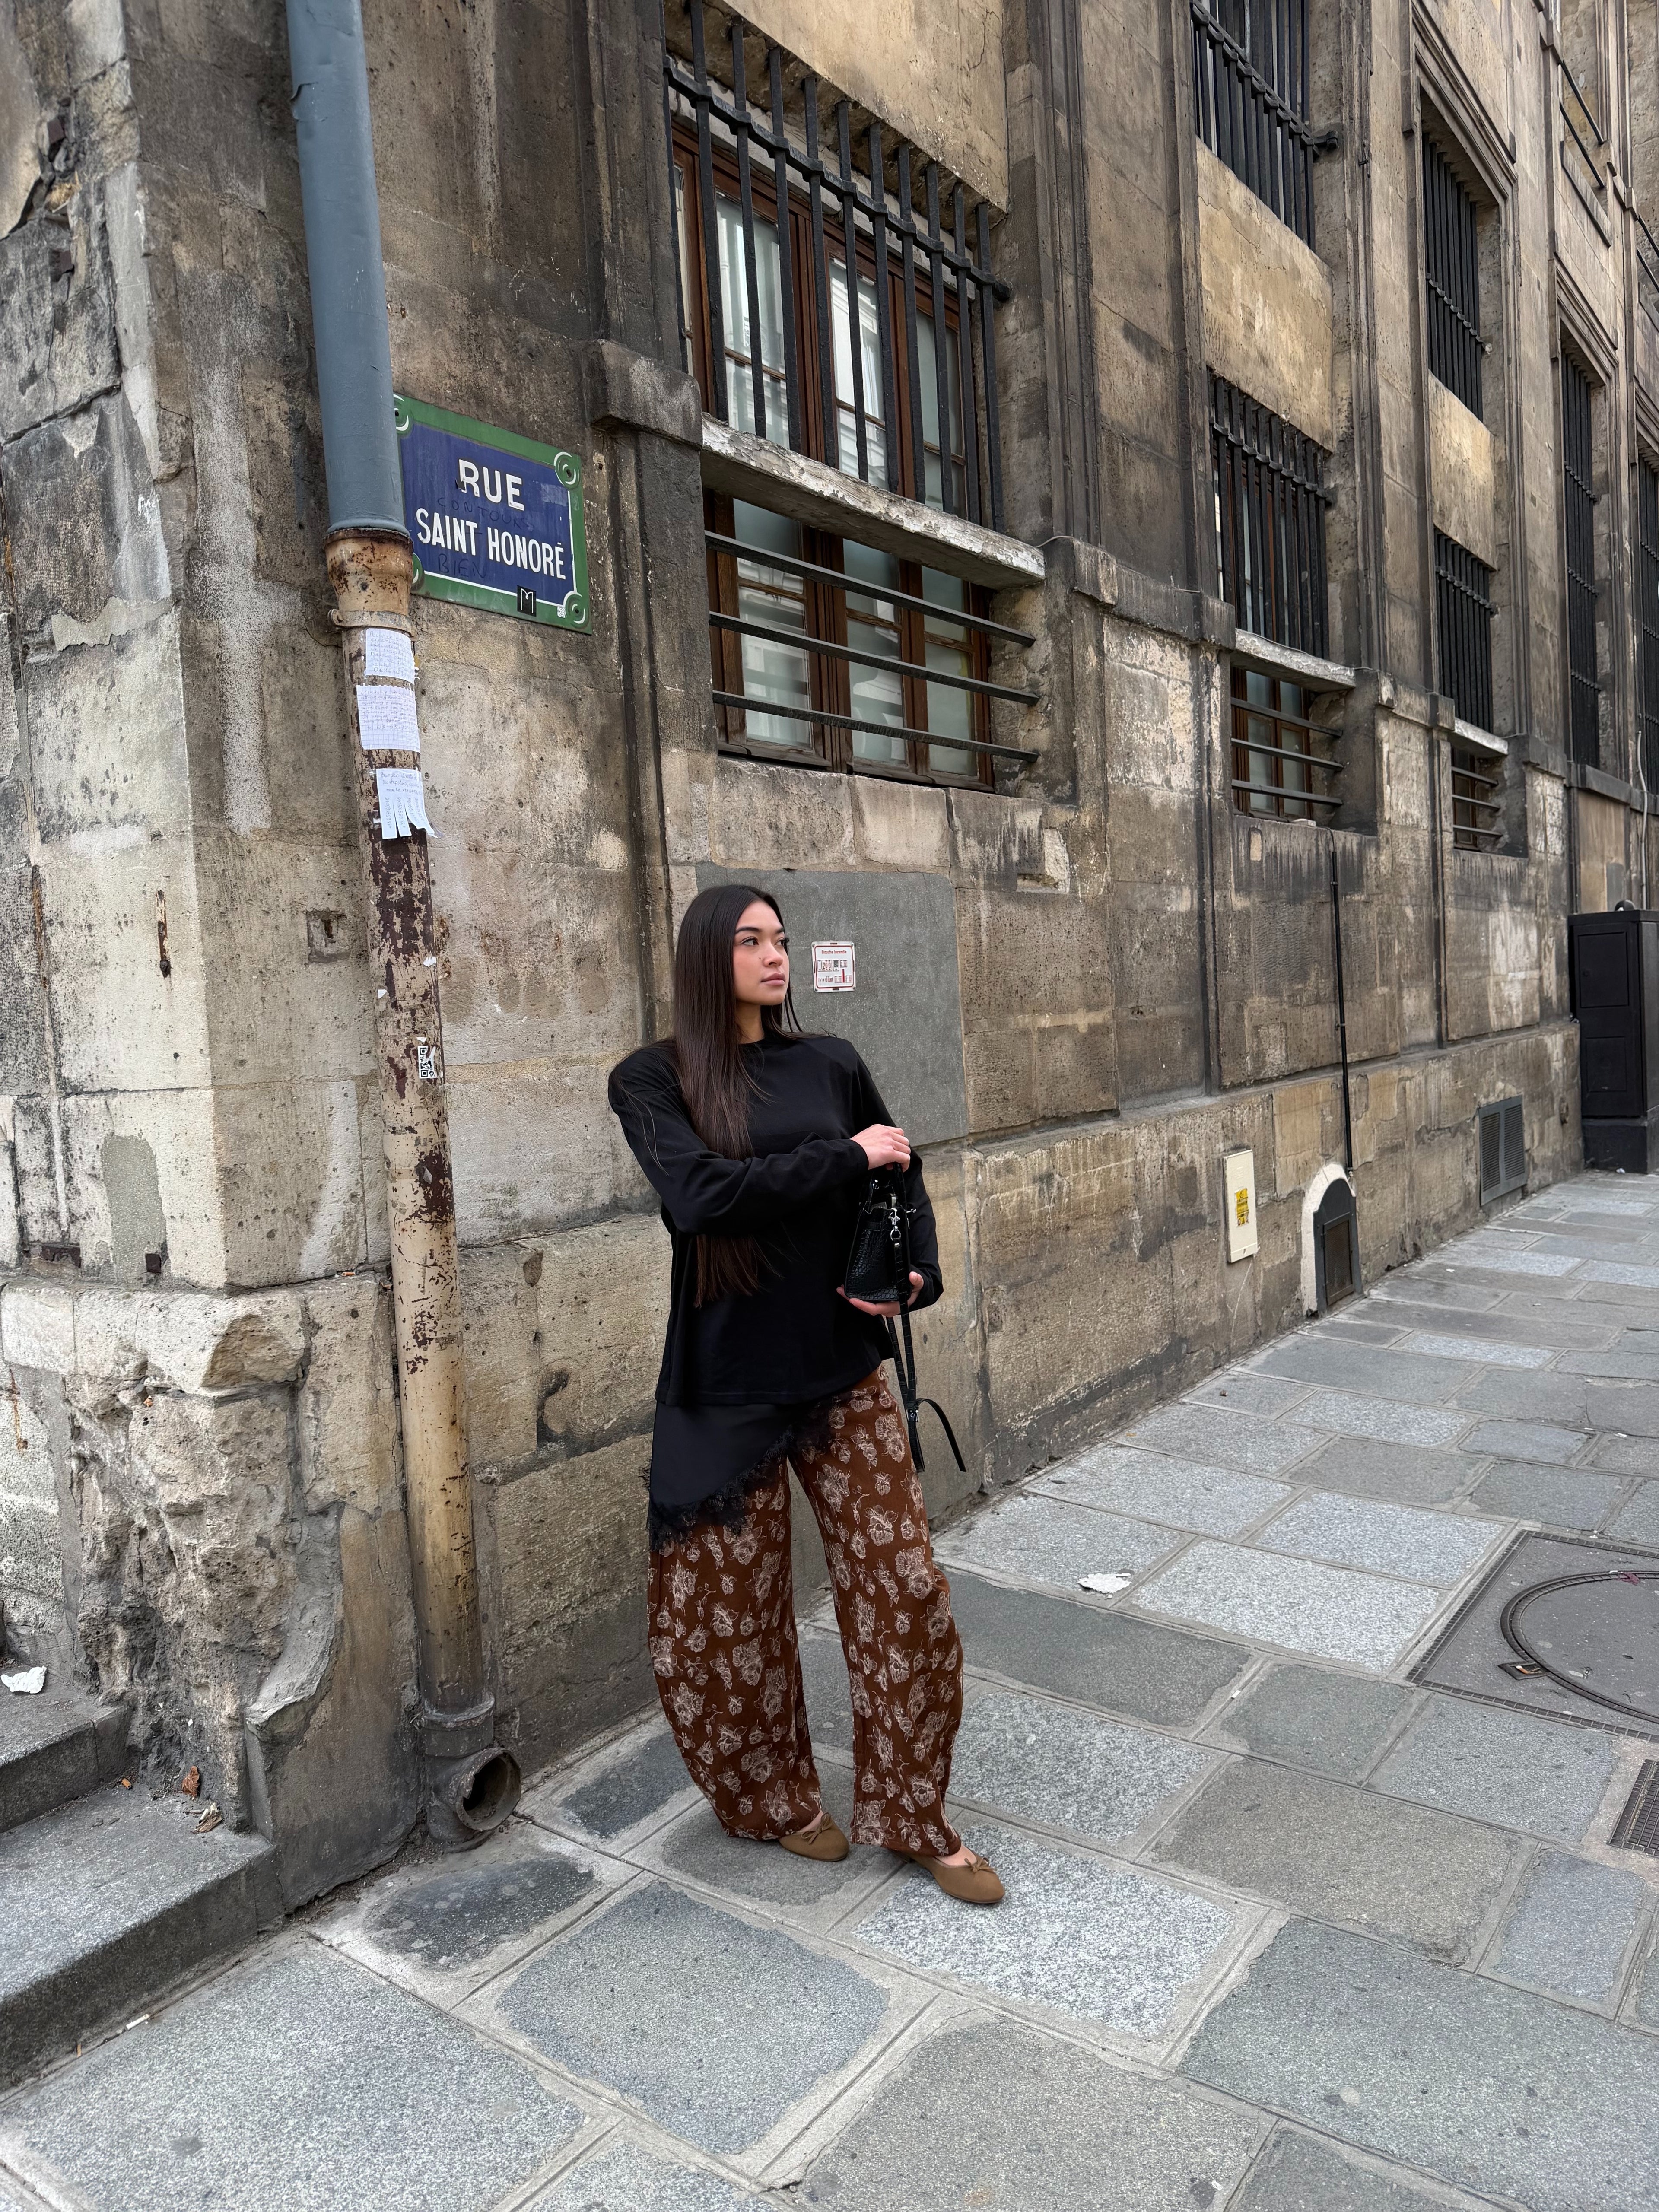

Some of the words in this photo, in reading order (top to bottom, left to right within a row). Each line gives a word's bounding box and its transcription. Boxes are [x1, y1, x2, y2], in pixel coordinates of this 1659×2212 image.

[458, 459, 524, 511] RUE
[416, 507, 478, 556] SAINT
[487, 527, 566, 580] HONORÉ
[438, 553, 488, 579] BIEN
